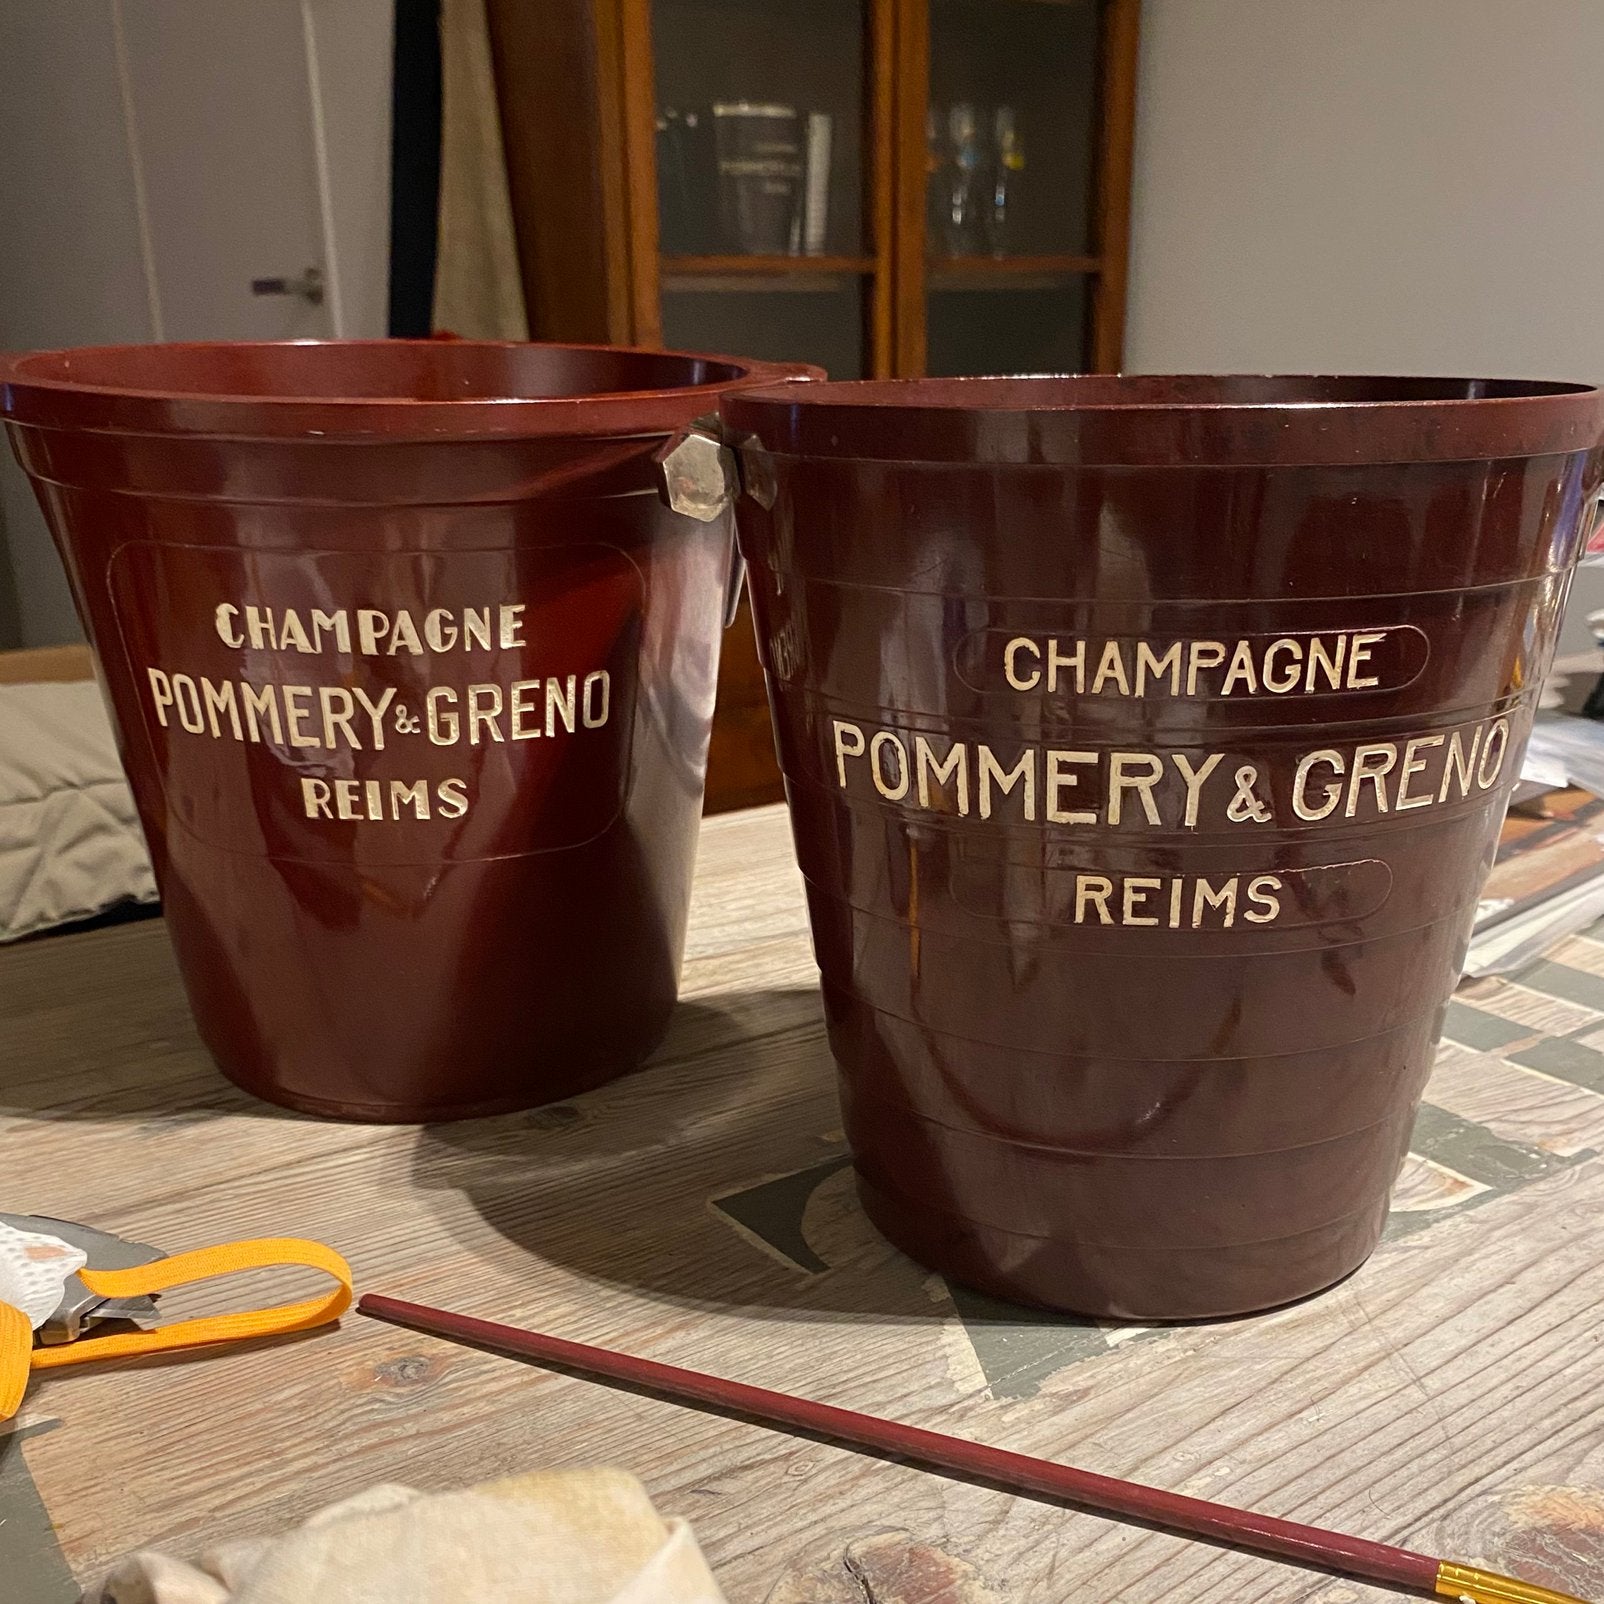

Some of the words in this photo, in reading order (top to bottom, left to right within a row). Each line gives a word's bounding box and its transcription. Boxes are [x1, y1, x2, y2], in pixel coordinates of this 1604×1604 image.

[215, 603, 526, 656] CHAMPAGNE
[1003, 631, 1388, 698] CHAMPAGNE
[147, 667, 398, 751] POMMERY
[426, 669, 611, 747] GRENO
[300, 777, 469, 821] REIMS
[832, 719, 1226, 828] POMMERY
[1226, 765, 1272, 824] &
[1292, 717, 1511, 823] GRENO
[1073, 874, 1283, 930] REIMS
